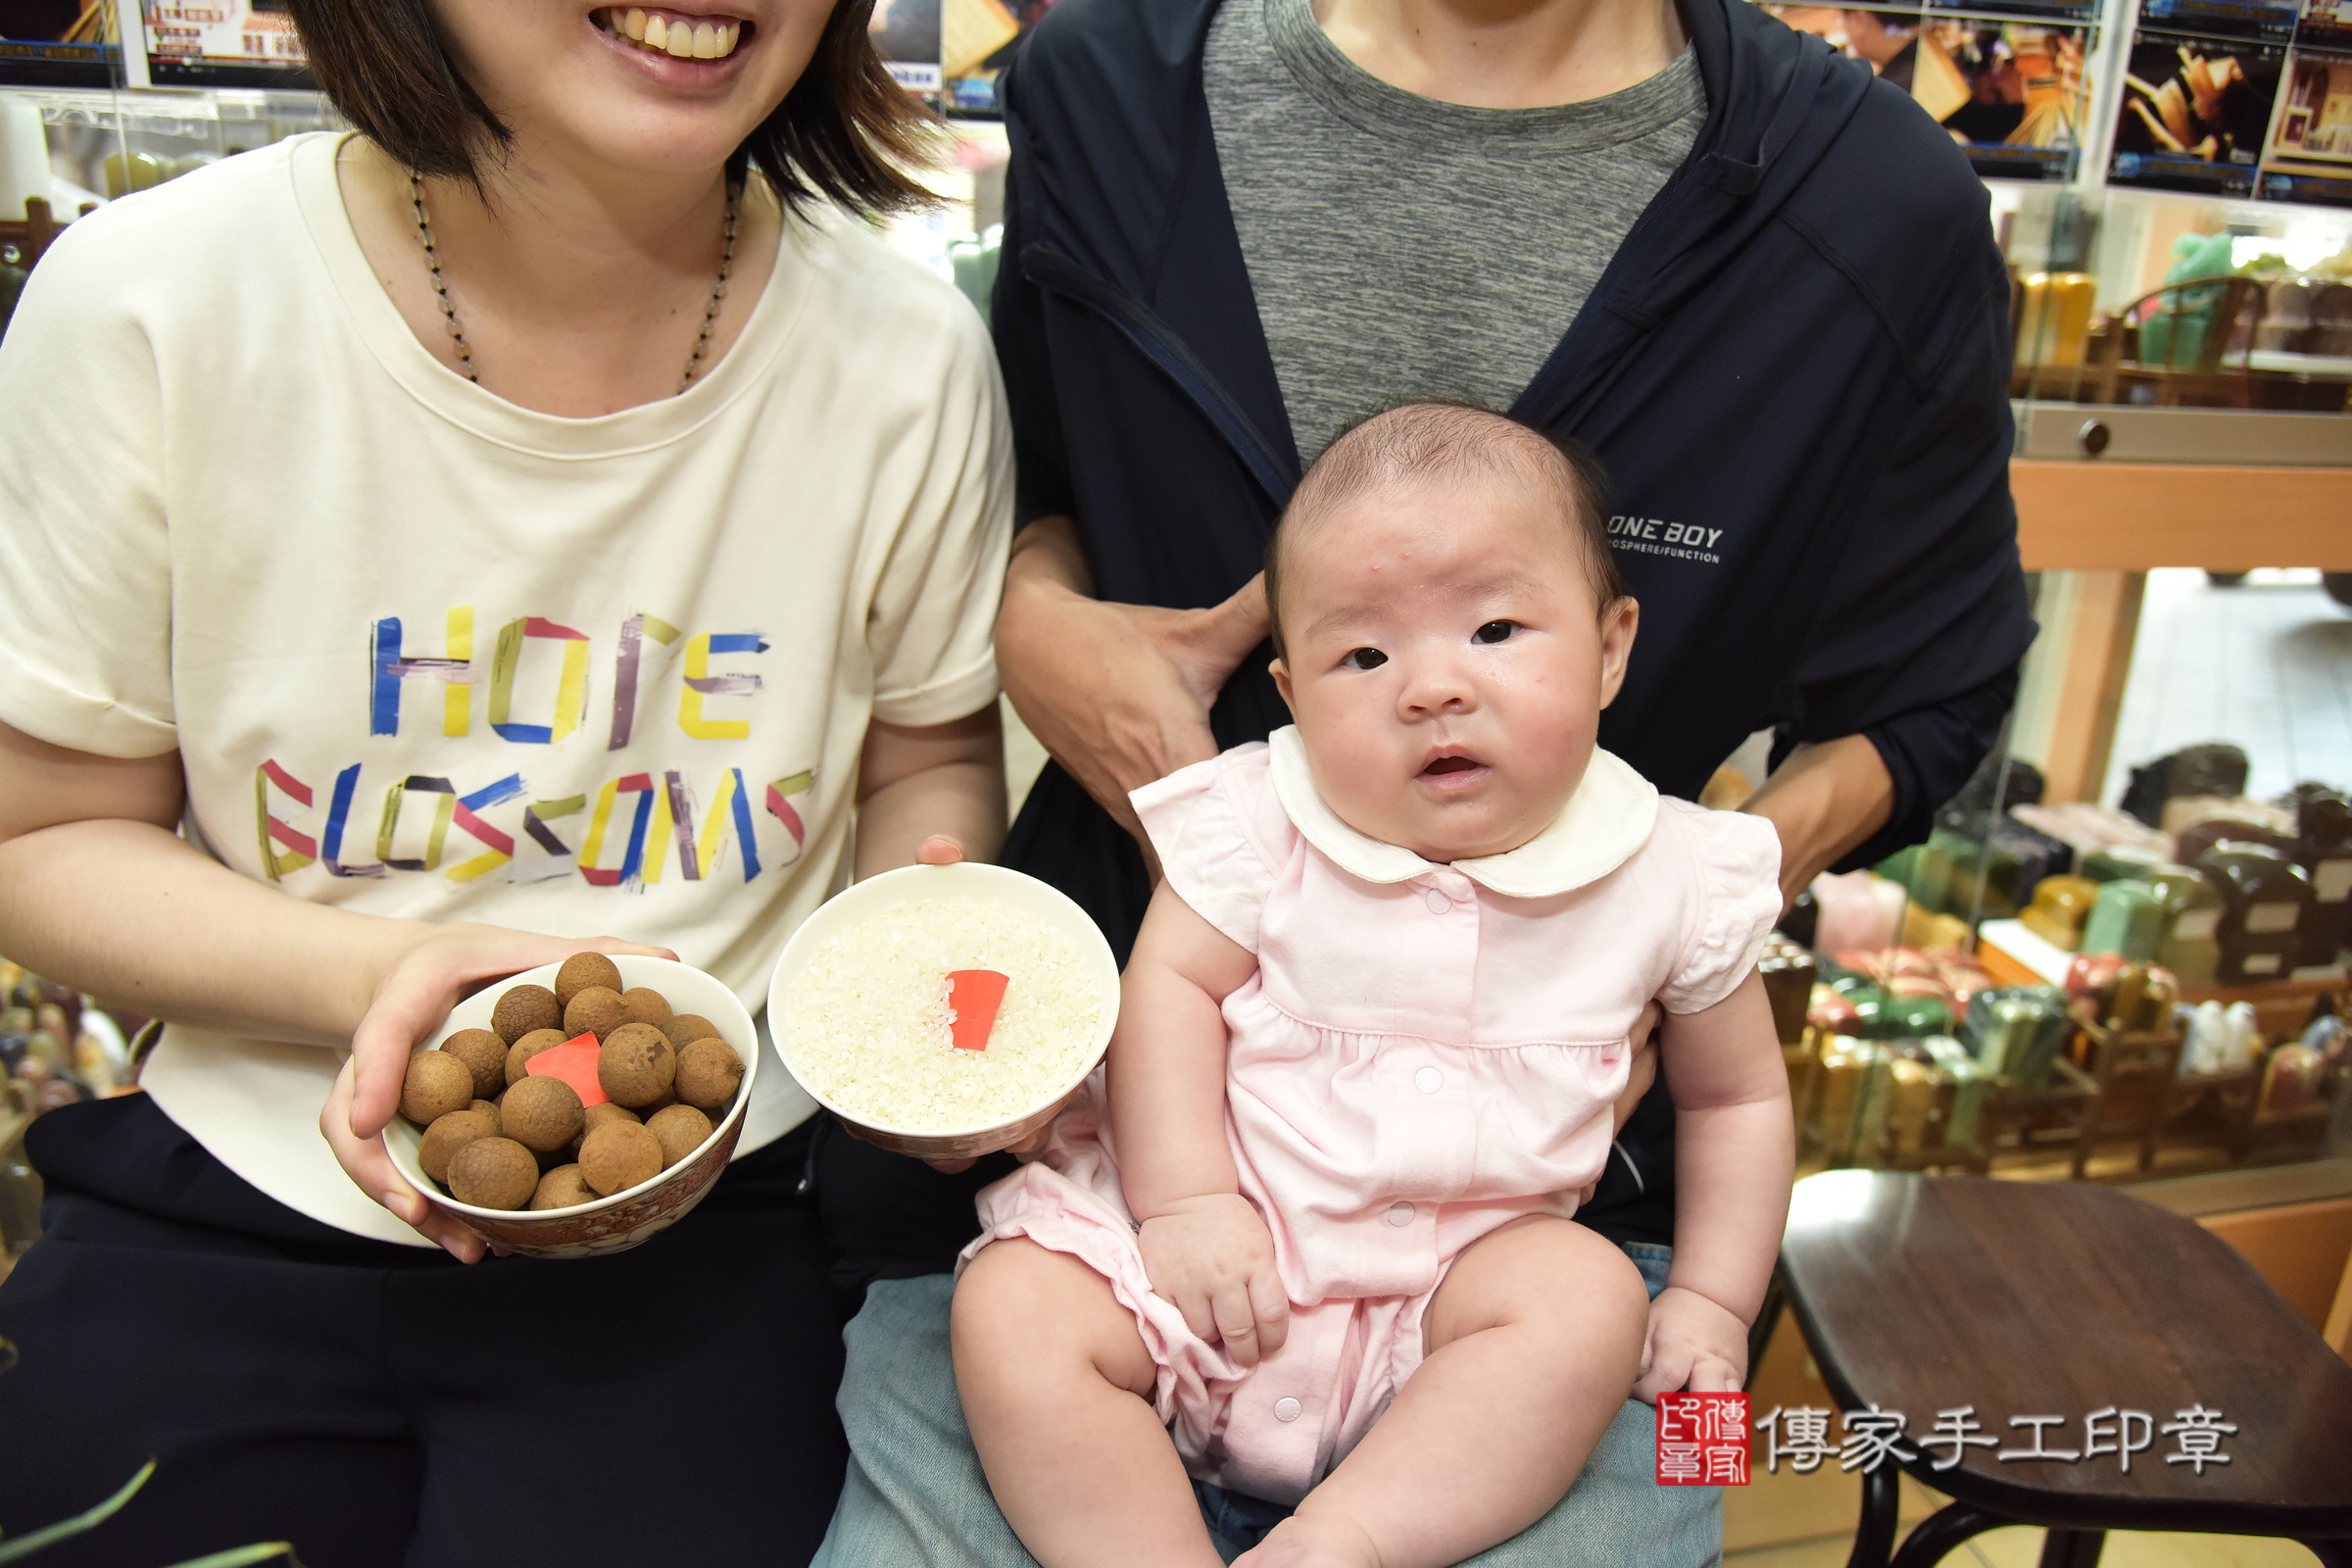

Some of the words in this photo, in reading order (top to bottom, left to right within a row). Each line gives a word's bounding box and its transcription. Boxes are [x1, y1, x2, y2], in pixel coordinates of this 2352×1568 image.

[1607, 515, 1663, 540] ONE
[1664, 522, 1723, 549] BOY
[1609, 540, 1720, 564] OSPHERE/FUNCTION
[369, 606, 770, 751] HOPE
[256, 759, 817, 893] BLOSSOMS
